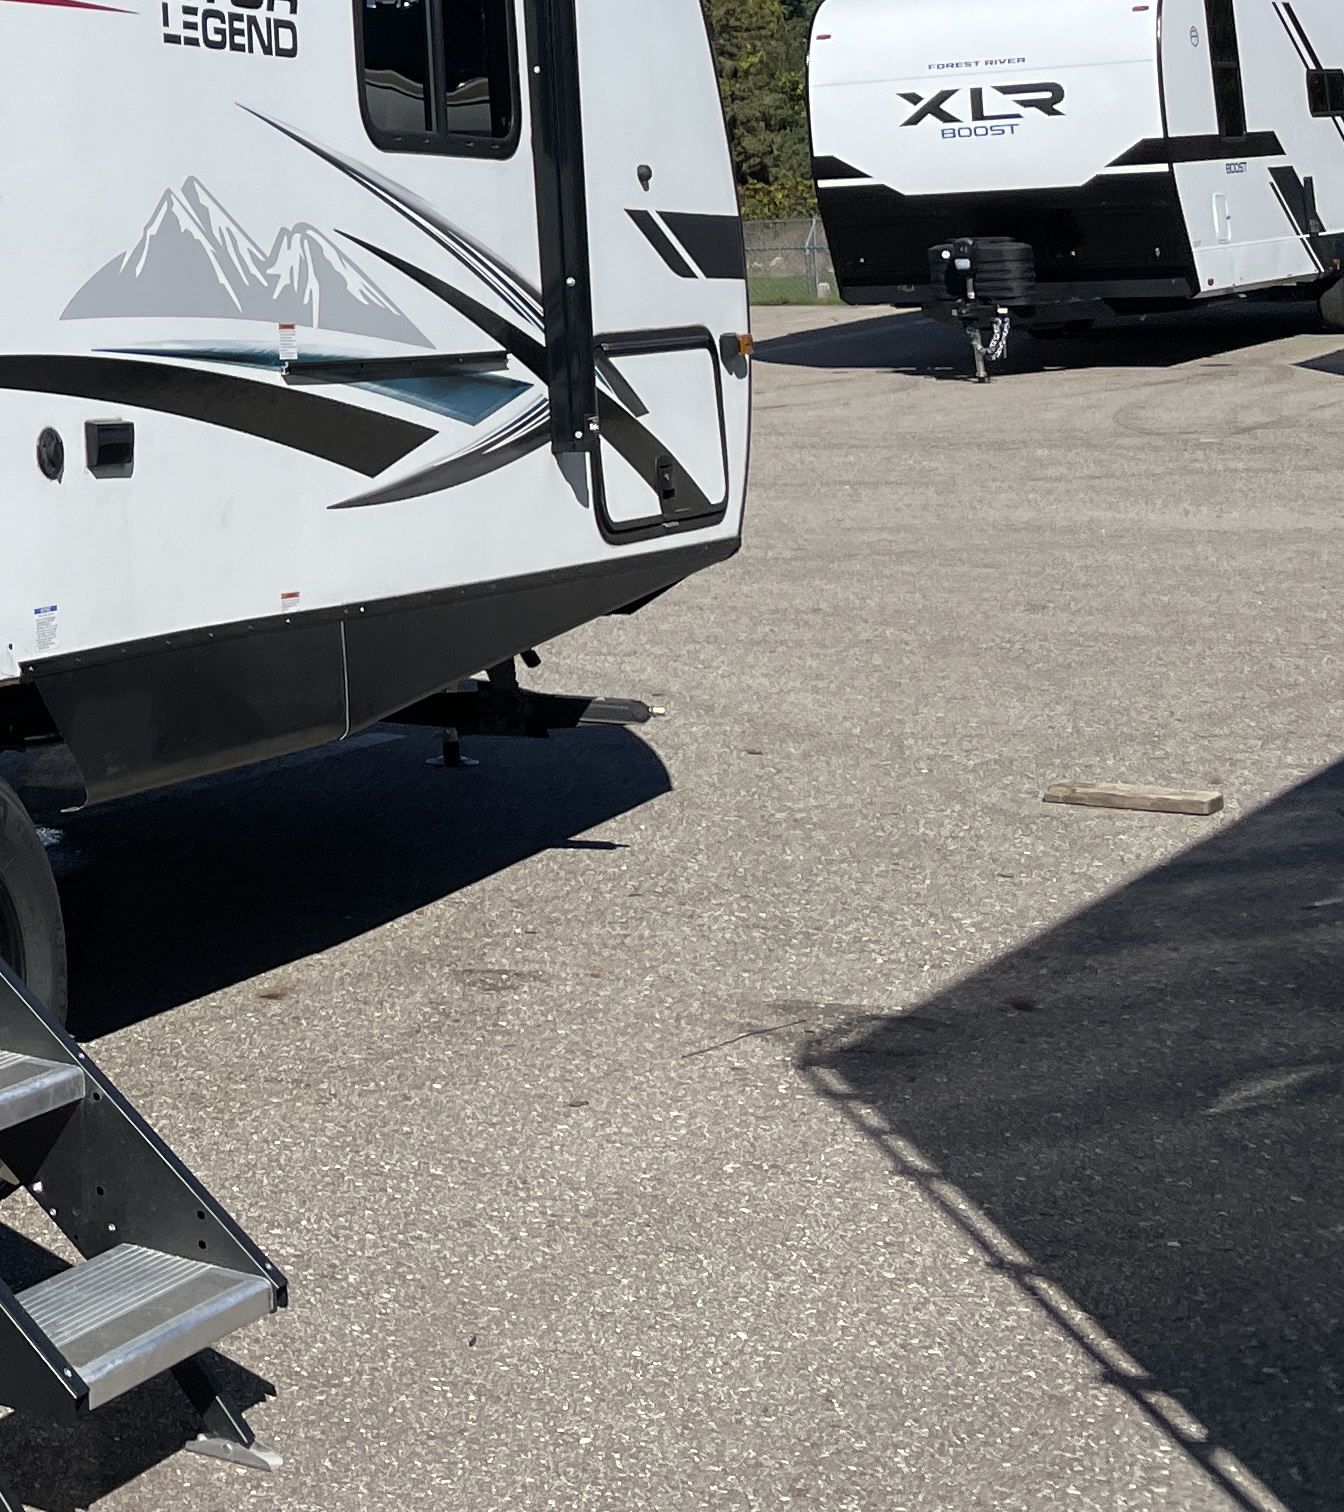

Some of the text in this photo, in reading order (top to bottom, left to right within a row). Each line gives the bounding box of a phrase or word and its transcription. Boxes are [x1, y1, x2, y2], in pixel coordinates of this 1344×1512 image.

[161, 1, 298, 58] LEGEND
[928, 57, 1026, 70] FOREST RIVER
[896, 82, 1066, 127] XLR
[941, 123, 1020, 139] BOOST
[1226, 162, 1247, 174] BOOST
